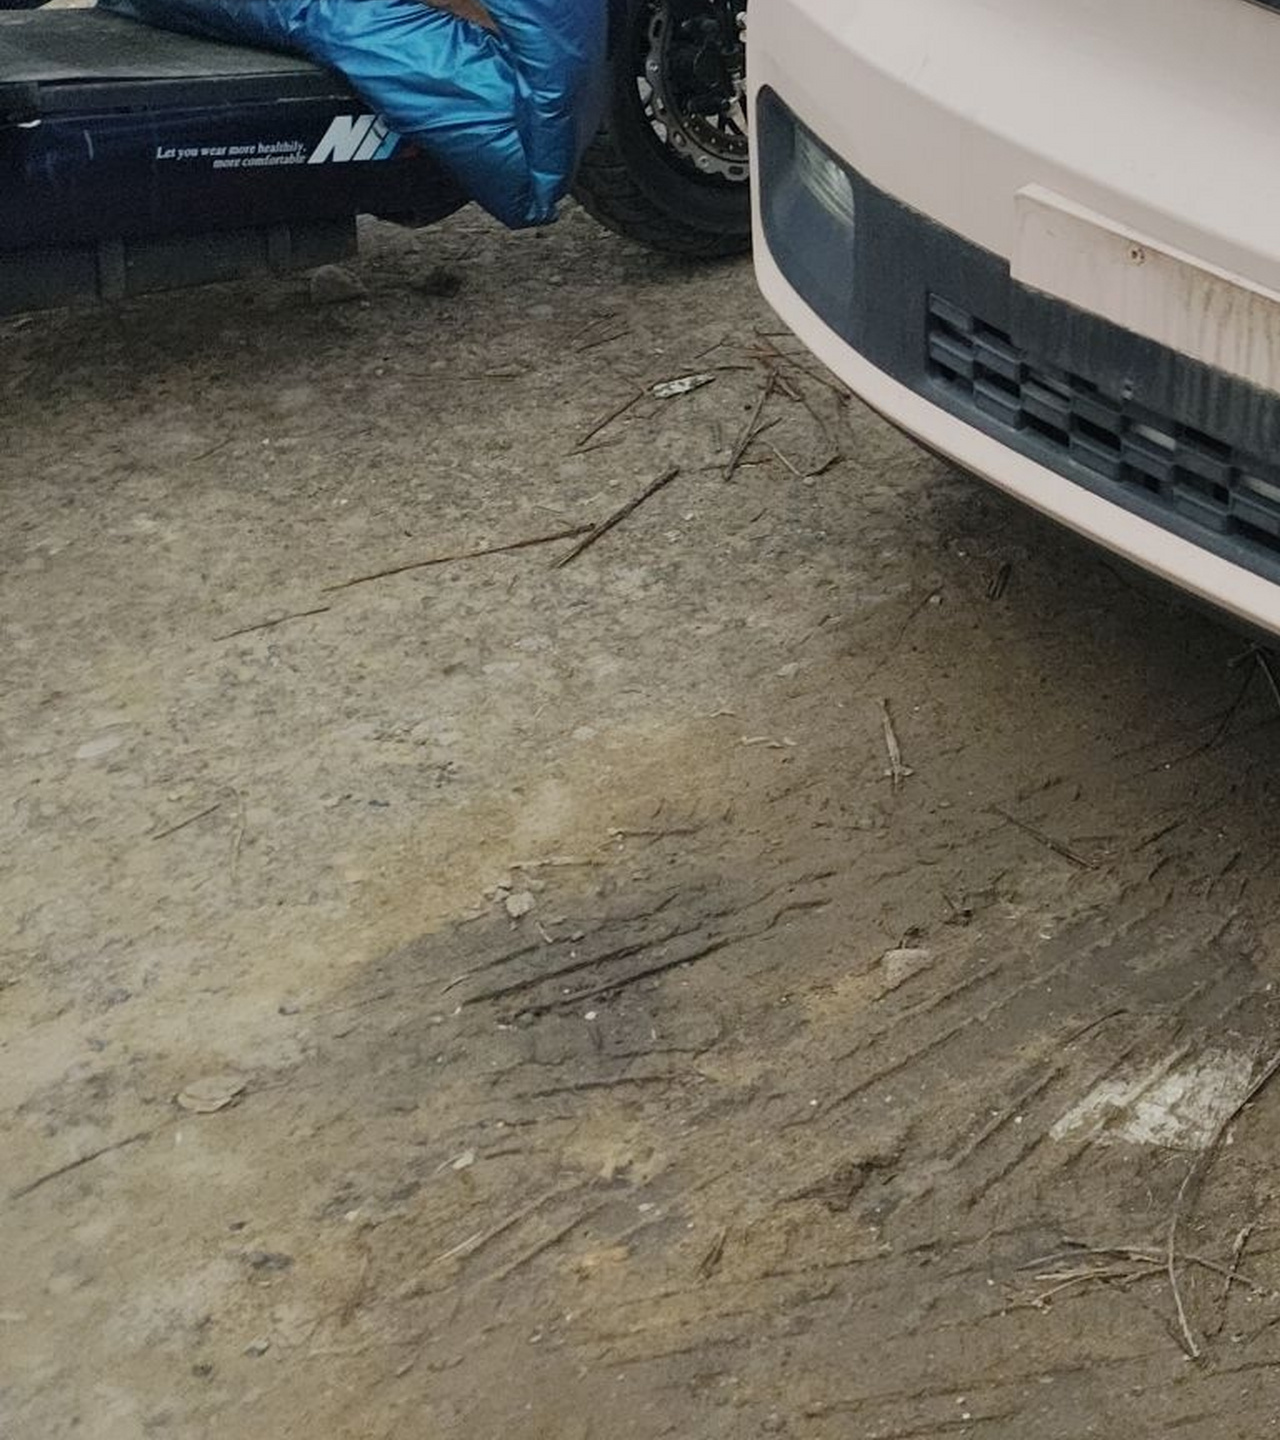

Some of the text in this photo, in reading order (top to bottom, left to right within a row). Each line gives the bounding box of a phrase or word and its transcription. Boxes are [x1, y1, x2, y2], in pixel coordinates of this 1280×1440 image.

[156, 146, 176, 159] Let
[177, 147, 198, 160] you
[200, 146, 227, 157] wear
[228, 145, 256, 156] more
[213, 153, 306, 169] more comfortable
